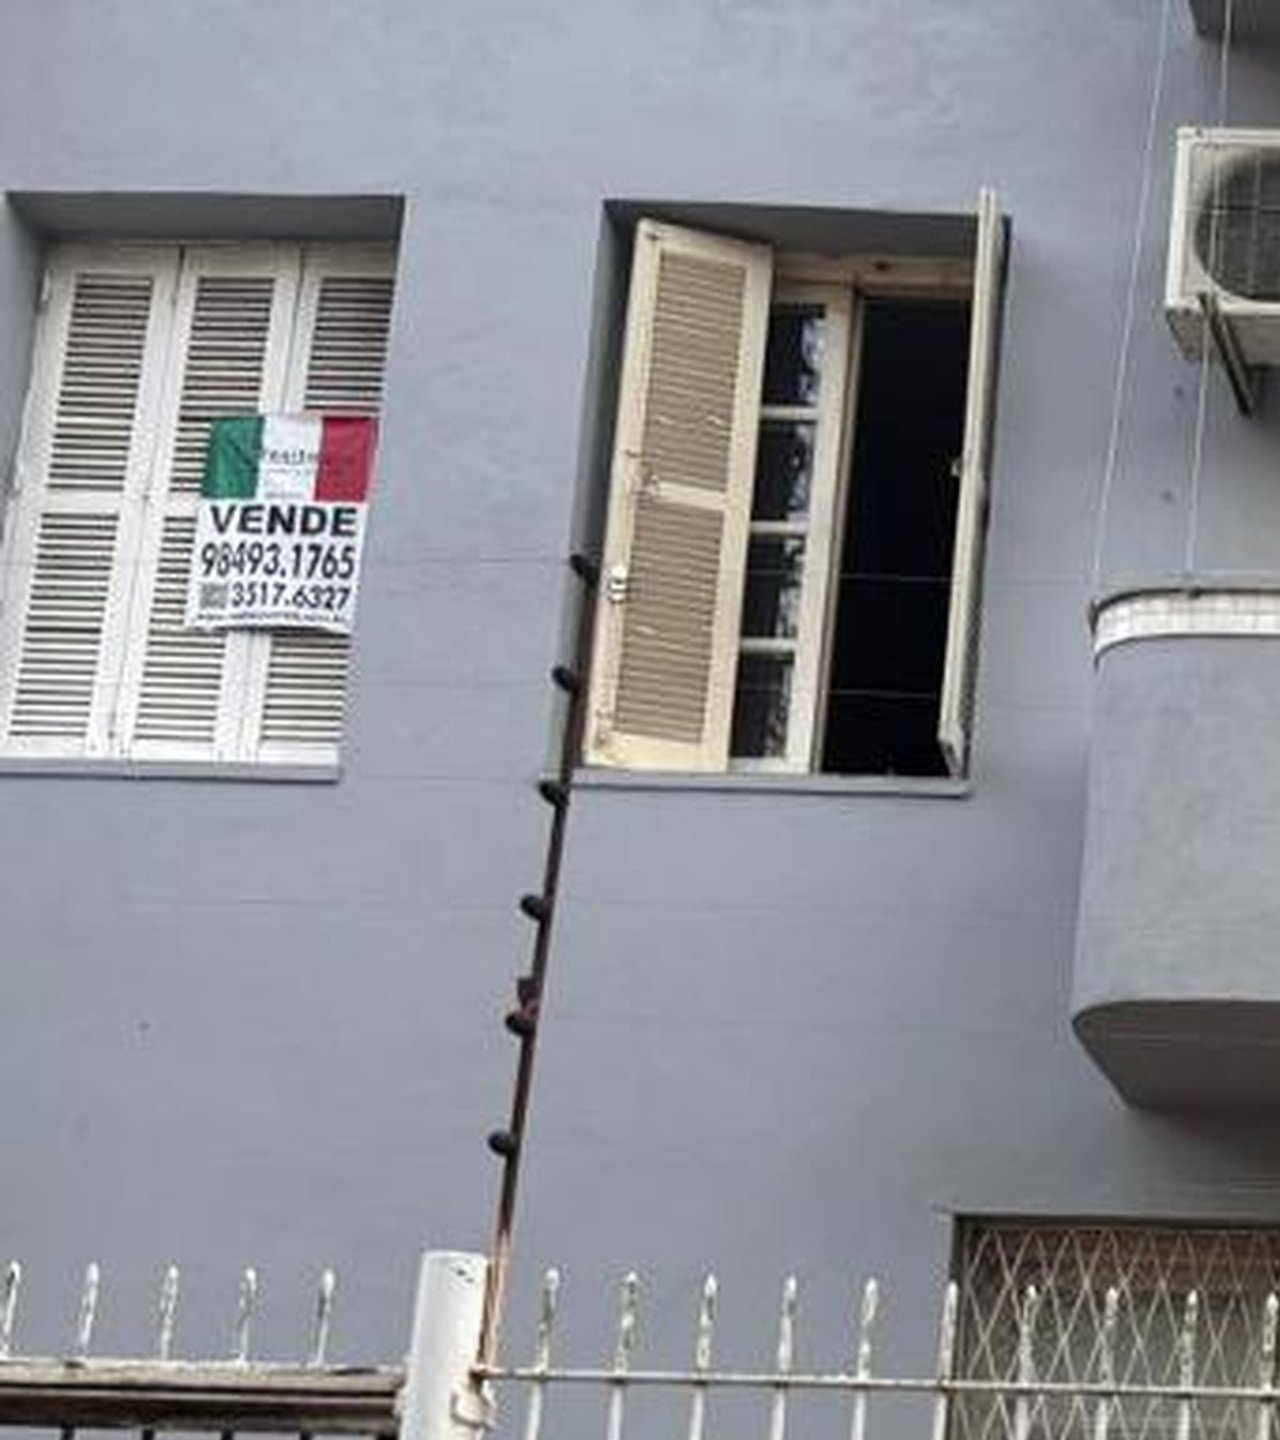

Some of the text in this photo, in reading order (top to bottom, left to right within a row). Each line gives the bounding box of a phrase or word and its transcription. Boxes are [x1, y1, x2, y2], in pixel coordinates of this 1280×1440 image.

[209, 504, 358, 538] VENDE
[201, 542, 356, 580] 98493.1765
[232, 581, 350, 611] 3517.6327
